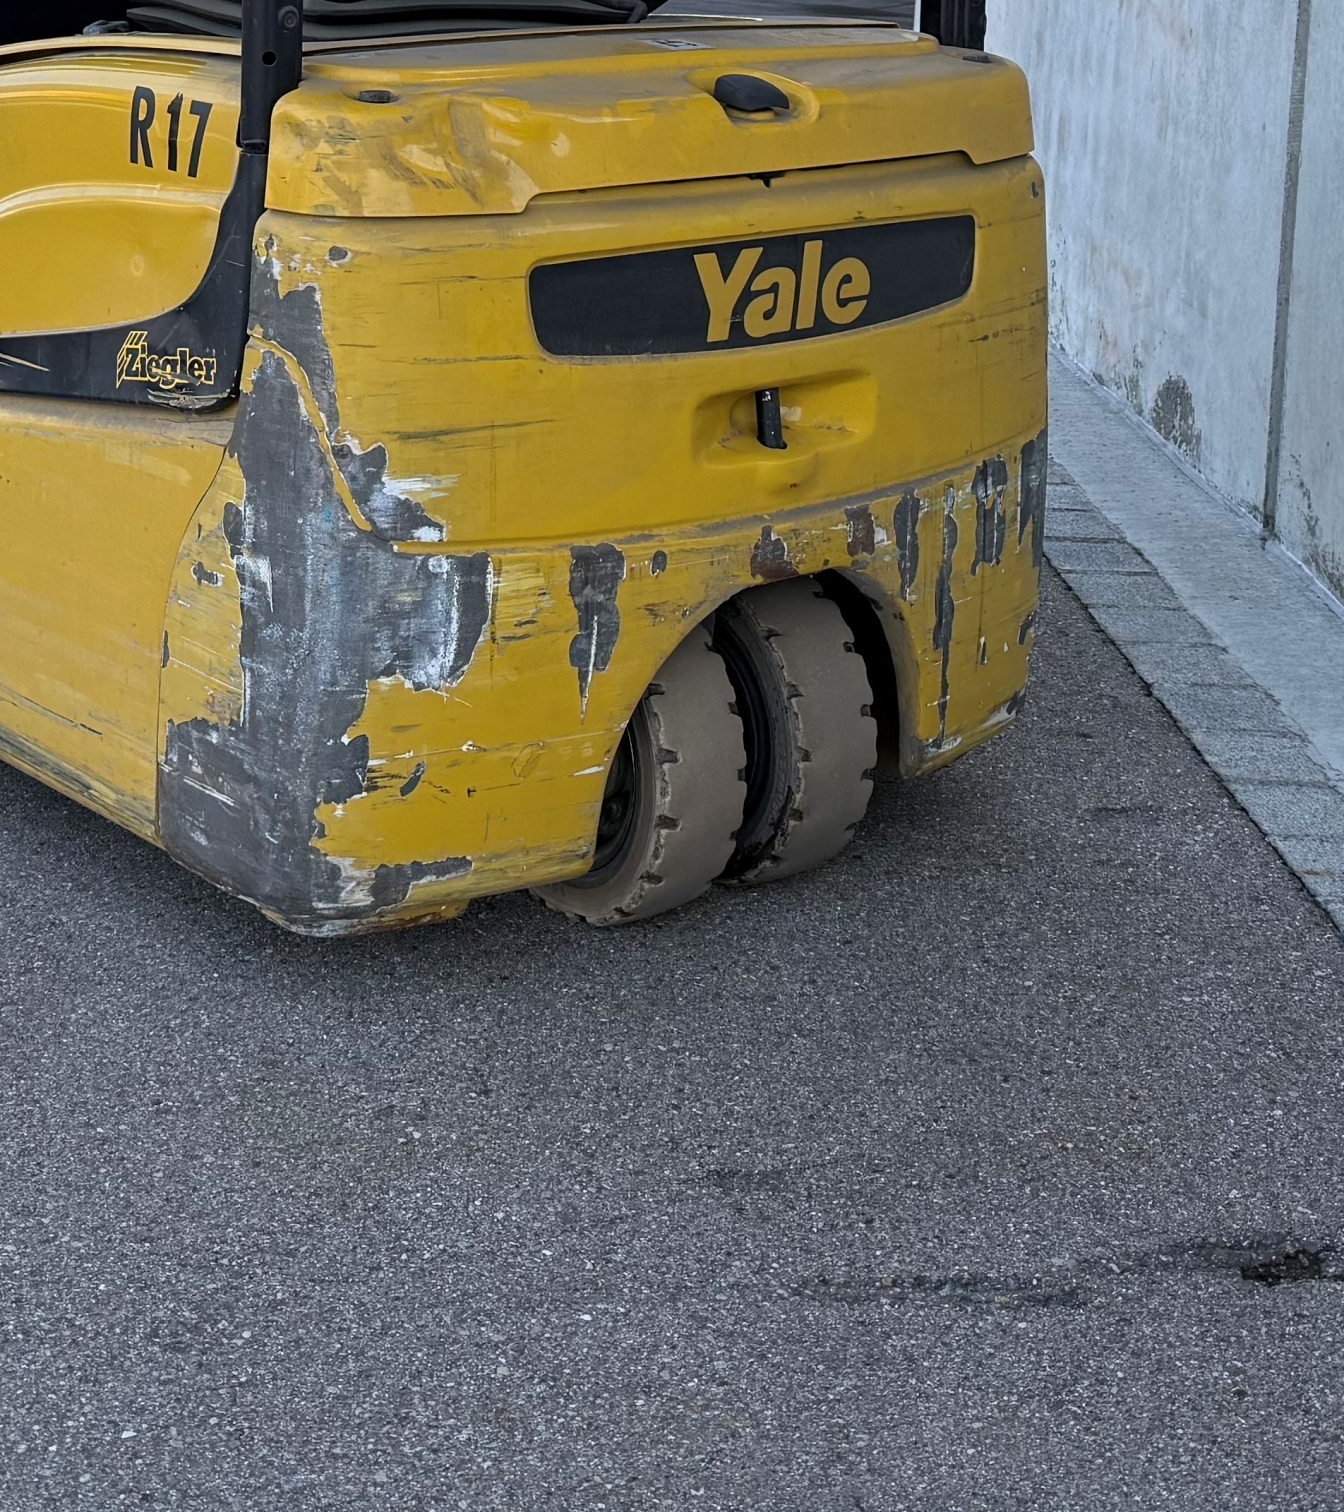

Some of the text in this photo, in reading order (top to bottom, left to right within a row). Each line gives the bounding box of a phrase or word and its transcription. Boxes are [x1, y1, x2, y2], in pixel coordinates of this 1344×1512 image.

[130, 85, 213, 178] R17
[693, 239, 871, 343] Yale
[119, 337, 216, 390] Ziegler
